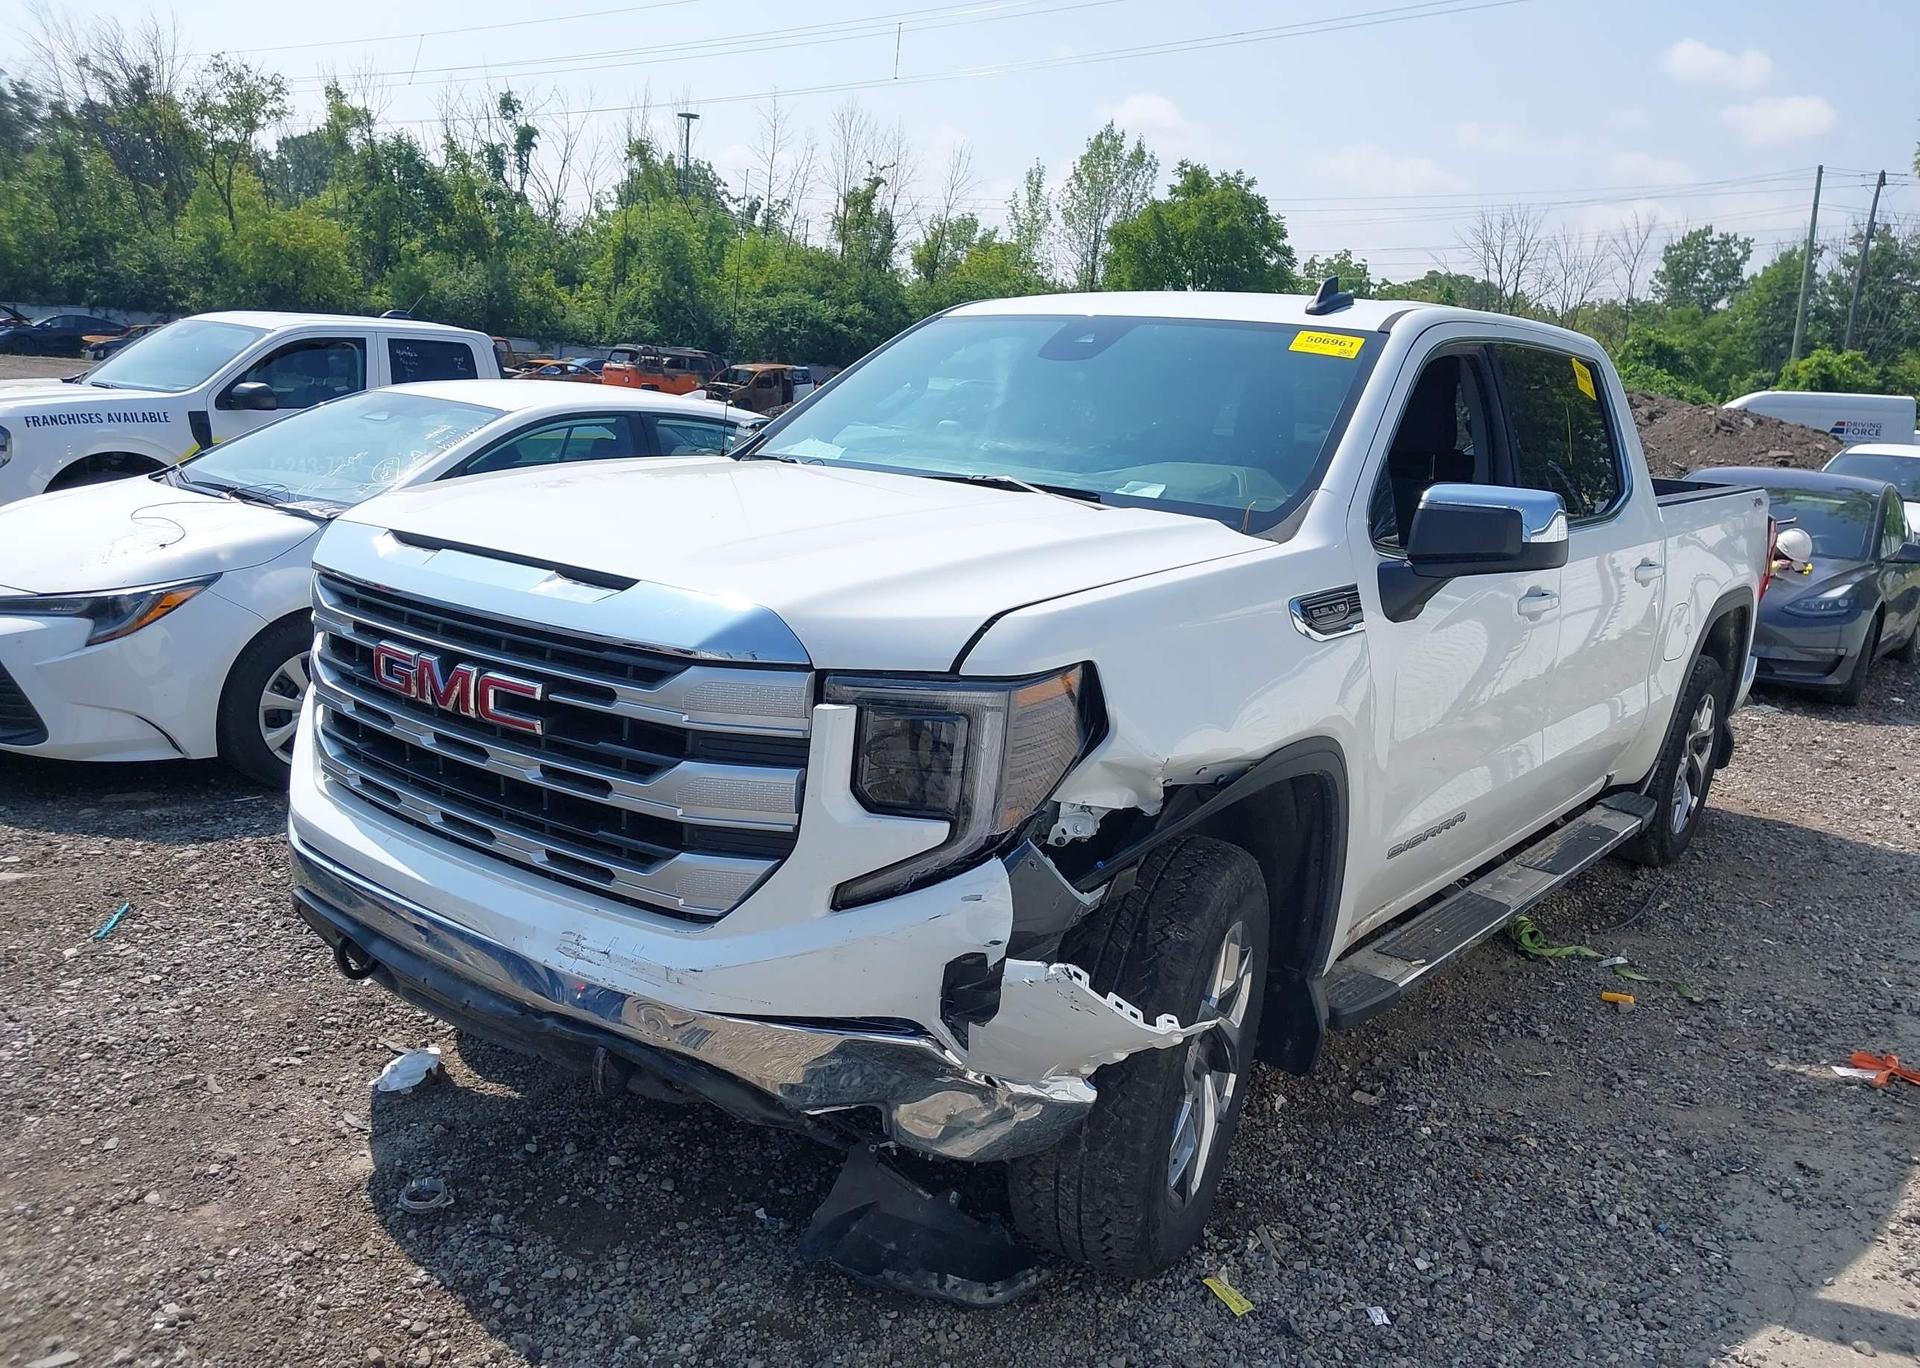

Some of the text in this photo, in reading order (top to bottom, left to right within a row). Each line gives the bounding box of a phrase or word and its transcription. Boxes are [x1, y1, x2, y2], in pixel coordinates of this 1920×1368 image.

[1304, 334, 1355, 349] 506961
[24, 411, 171, 428] FRANCHISES AVAILABLE
[1846, 420, 1882, 430] DRIVING
[1845, 427, 1881, 437] FORCE
[373, 639, 543, 736] GMC
[1386, 811, 1467, 860] SIERRA
